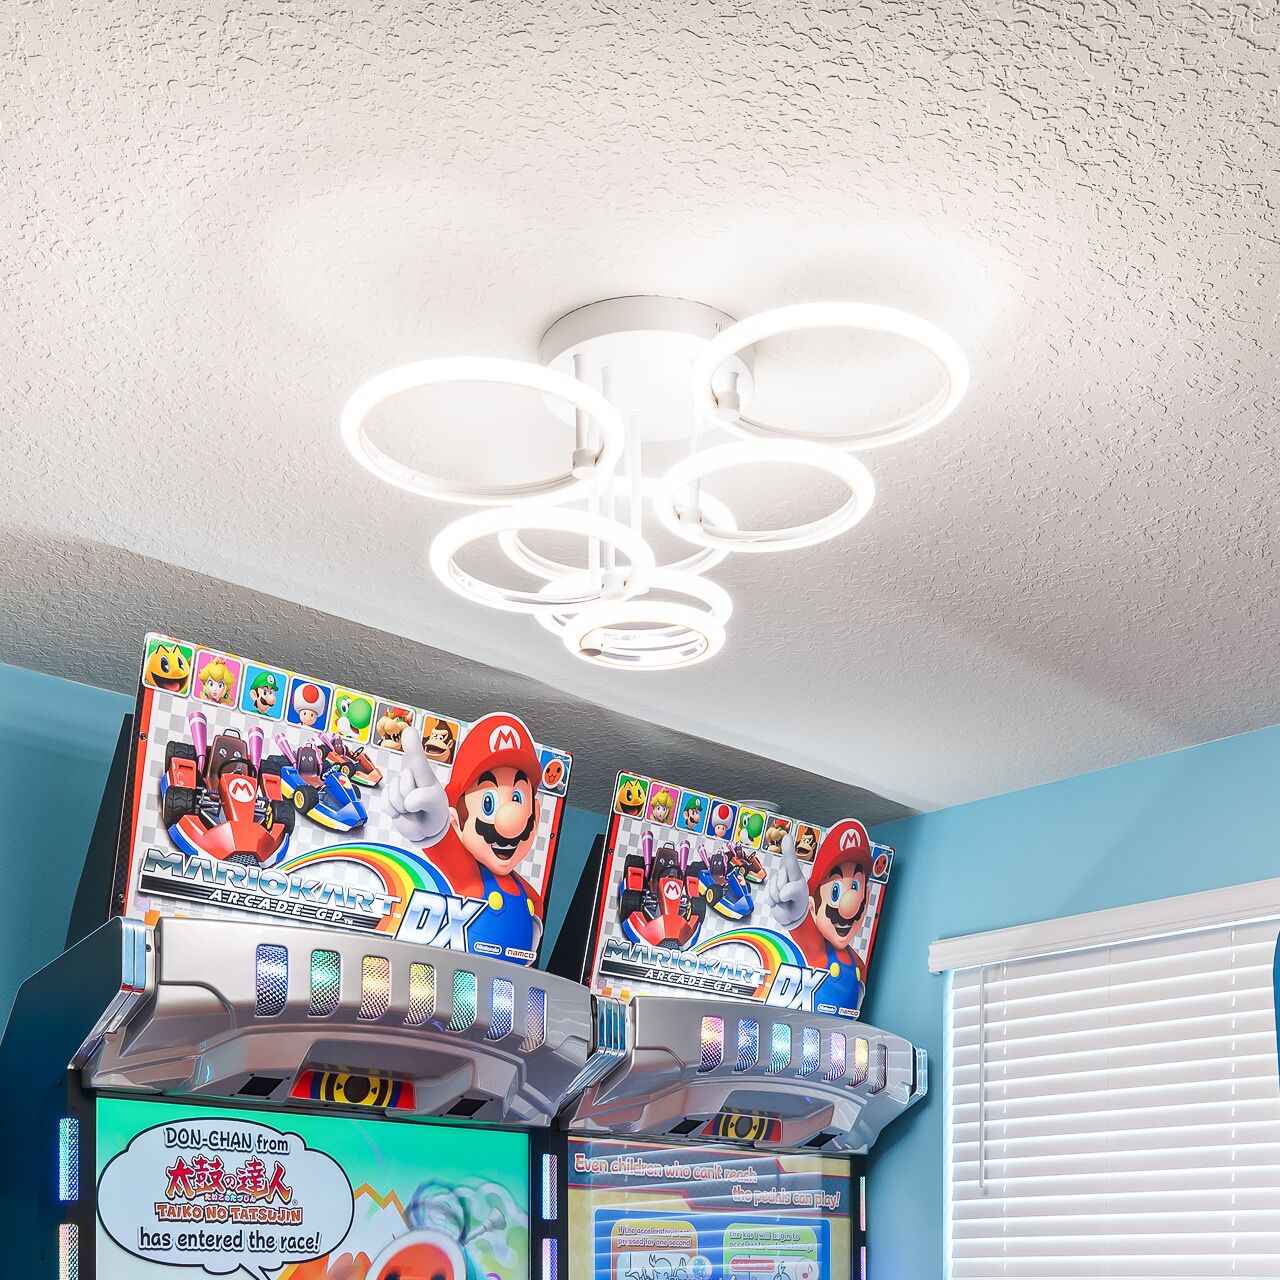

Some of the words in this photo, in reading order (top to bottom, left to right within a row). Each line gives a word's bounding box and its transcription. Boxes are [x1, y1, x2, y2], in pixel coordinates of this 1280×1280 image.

[209, 889, 302, 915] ARCADE
[394, 888, 488, 953] DX
[507, 948, 535, 959] namco
[643, 968, 706, 989] ARCADE
[766, 963, 829, 1013] DX
[164, 1127, 253, 1152] DON-CHAN
[257, 1133, 290, 1153] from
[165, 1154, 293, 1205] 太鼓の達人
[574, 1153, 608, 1174] Even
[610, 1157, 662, 1177] children
[665, 1163, 691, 1179] who
[693, 1164, 723, 1181] can't
[725, 1167, 758, 1183] reach
[732, 1186, 752, 1202] the
[754, 1189, 791, 1207] pedals
[793, 1193, 813, 1207] can
[814, 1191, 841, 1211] play!
[155, 1202, 202, 1222] TAIKO
[205, 1204, 229, 1223] NO
[229, 1205, 303, 1225] TATSUJIN
[139, 1227, 171, 1250] has
[177, 1229, 244, 1251] entered
[248, 1230, 276, 1251] the
[280, 1231, 322, 1253] race!
[668, 1239, 692, 1248] second
[792, 1233, 801, 1242] to
